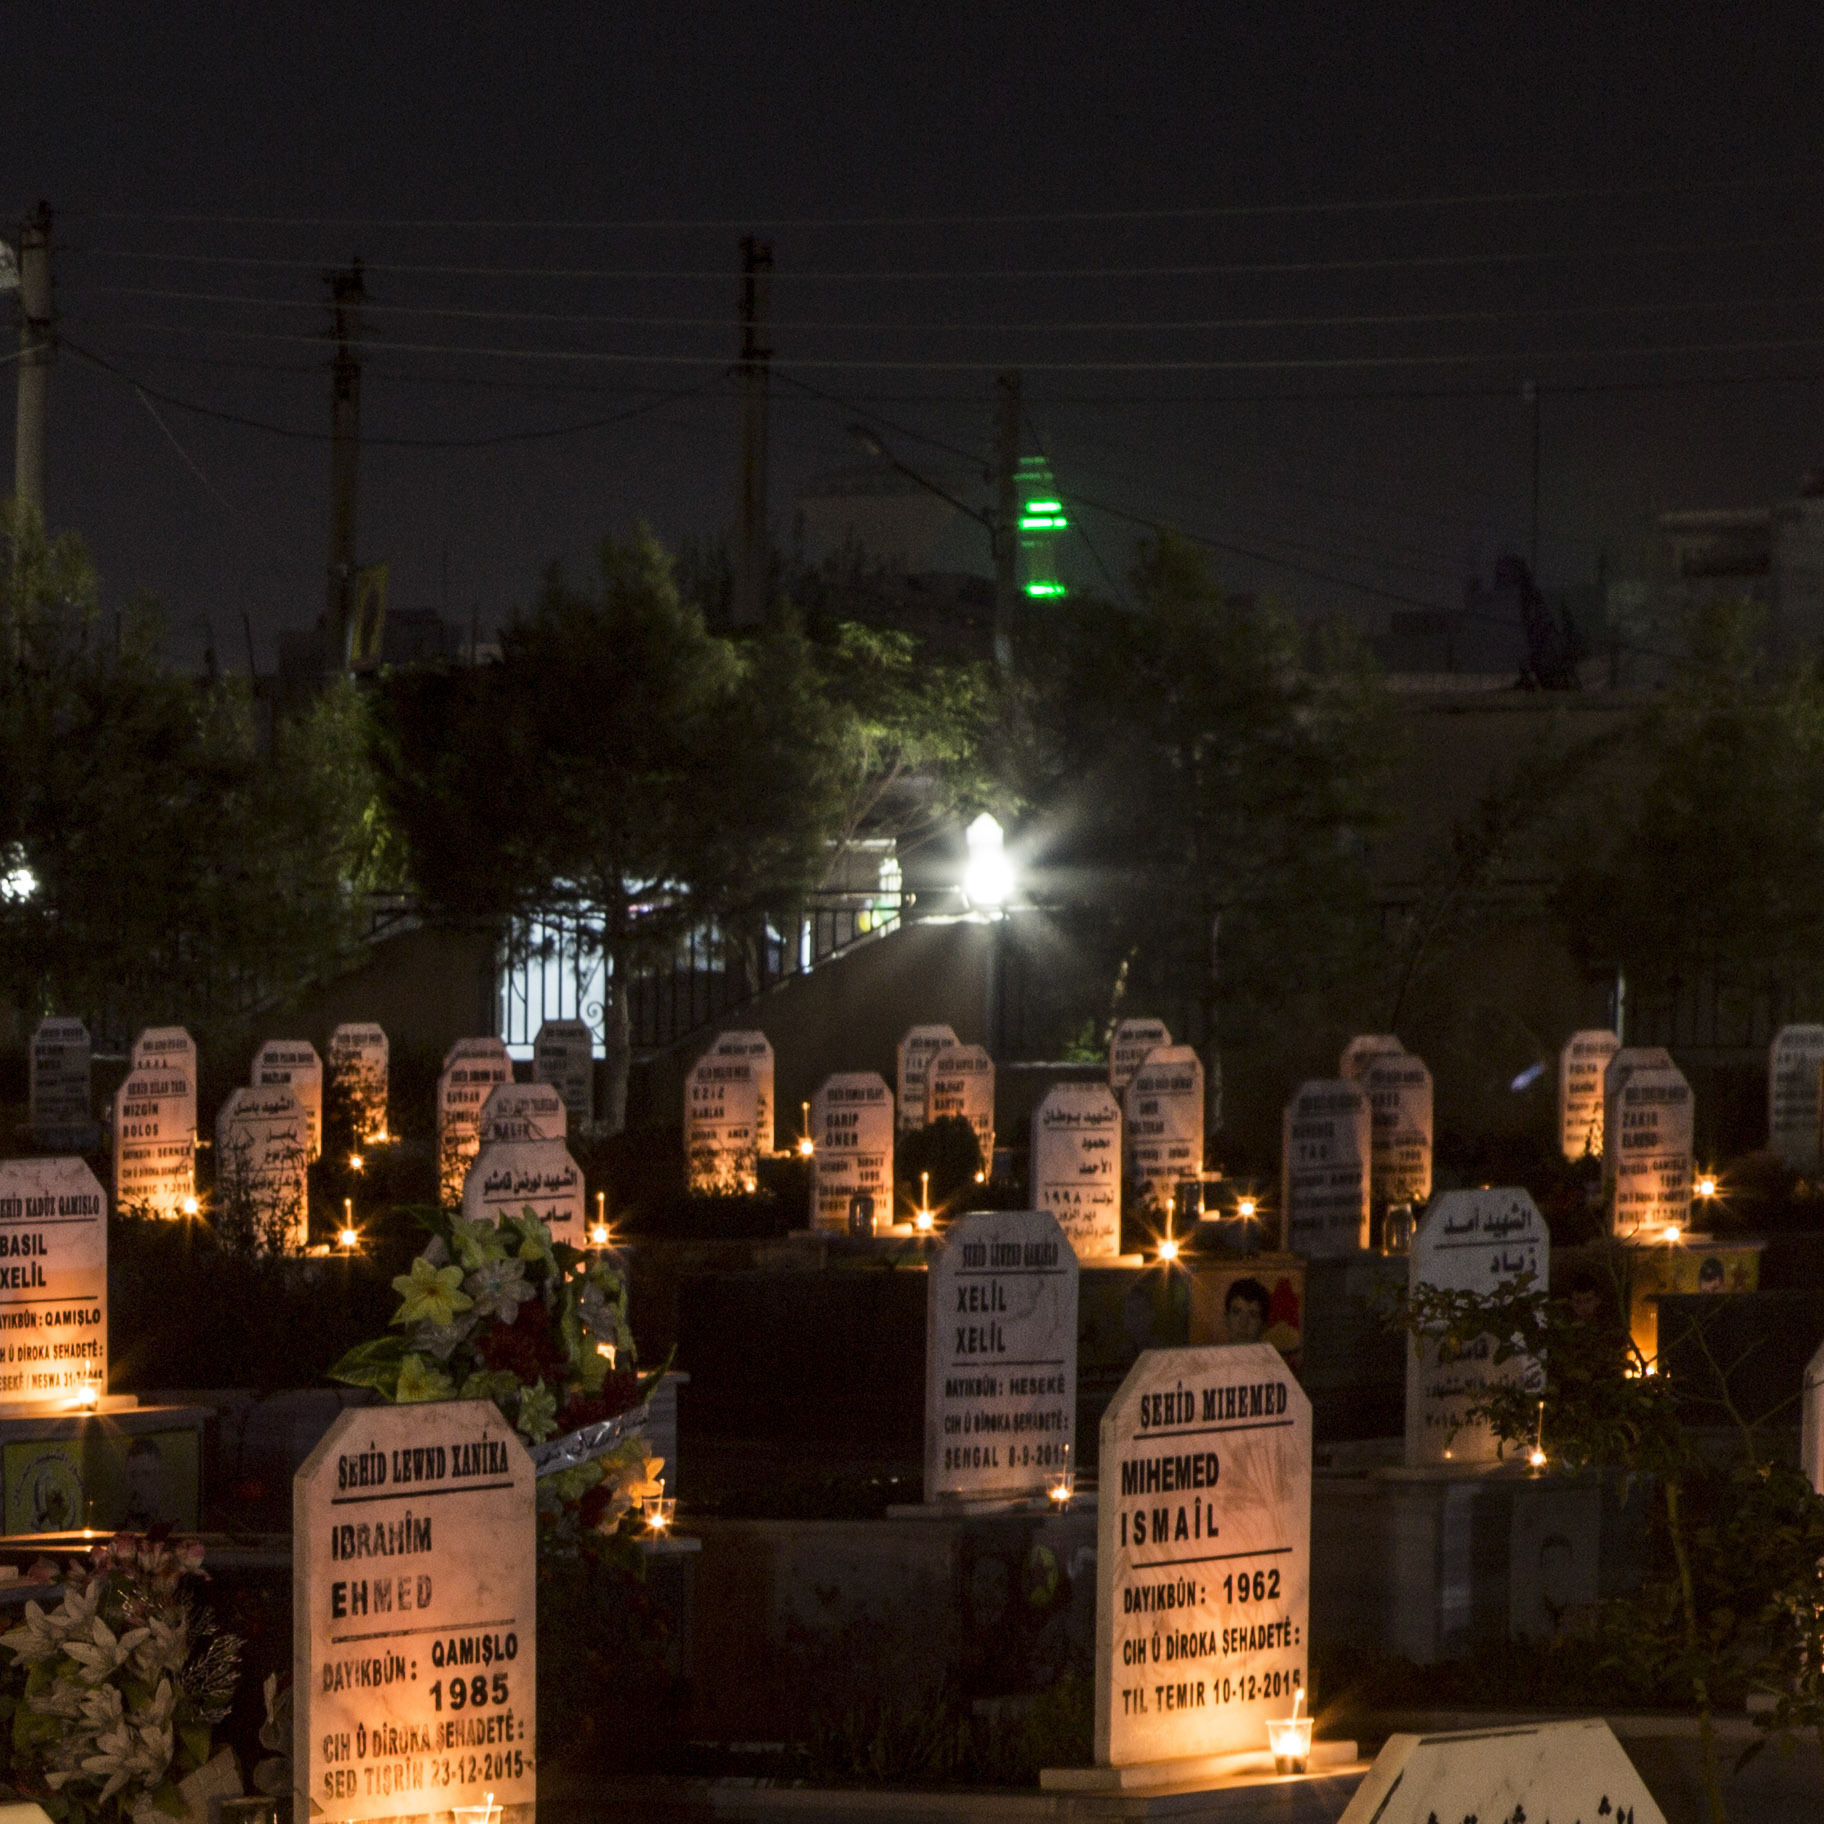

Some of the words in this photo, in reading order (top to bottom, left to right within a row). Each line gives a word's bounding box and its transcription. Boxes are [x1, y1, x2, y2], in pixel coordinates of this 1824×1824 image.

[1140, 1381, 1195, 1428] ŞEHÎD
[1202, 1382, 1287, 1421] MIHEMED
[1122, 1453, 1219, 1495] MIHEMED
[1121, 1497, 1219, 1547] ISMAÎL
[332, 1574, 432, 1619] EHMED
[1223, 1569, 1280, 1604] 1962
[432, 1633, 517, 1669] QAMIŞLO
[429, 1674, 509, 1711] 1985
[1156, 1682, 1205, 1712] TEMIR
[432, 1750, 523, 1785] 23-12-2015
